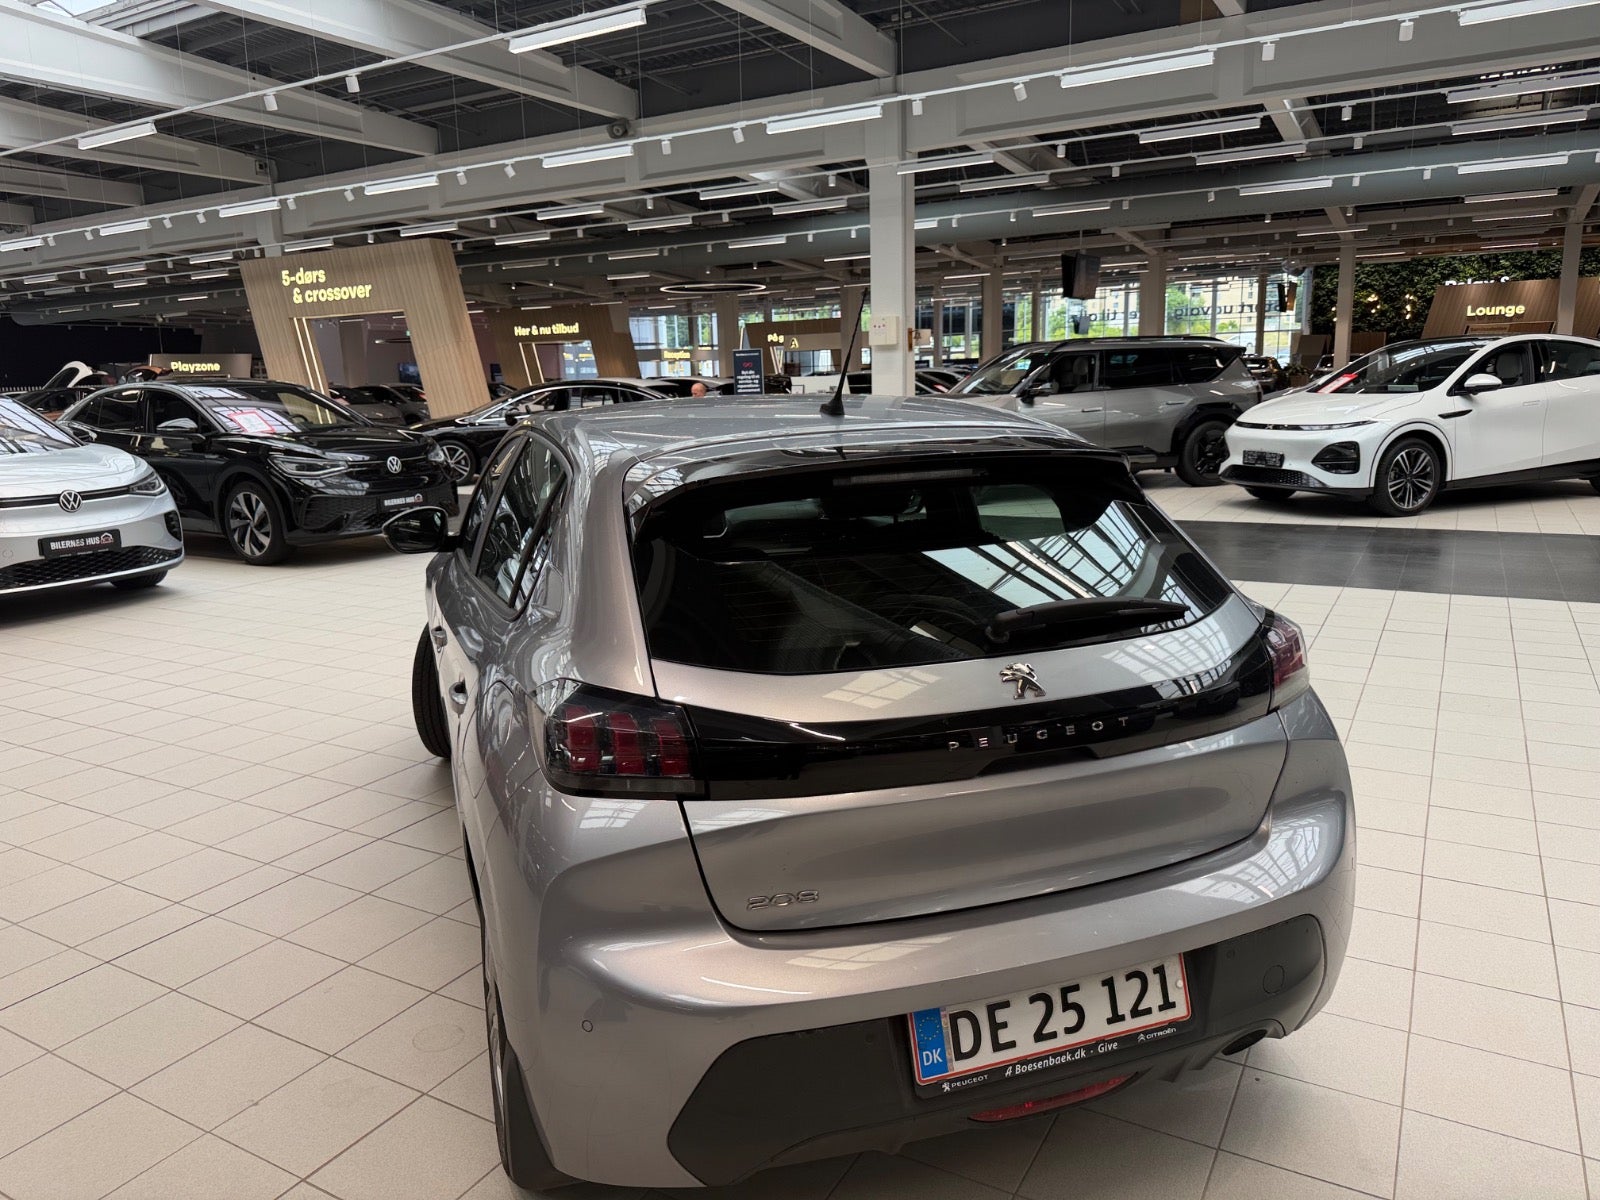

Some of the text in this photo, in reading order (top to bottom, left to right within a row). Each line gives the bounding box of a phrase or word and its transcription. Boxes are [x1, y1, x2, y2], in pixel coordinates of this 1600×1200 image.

[281, 267, 326, 286] 5-dørs
[293, 284, 372, 304] & crossover
[1466, 305, 1525, 317] Lounge
[514, 322, 579, 336] Her & nu tilbud
[170, 361, 221, 374] Playzone
[50, 536, 100, 550] BILERNES HUS
[949, 716, 1129, 751] PEUGEOT
[746, 889, 819, 911] 208
[922, 963, 1177, 1066] DK DE 25 121
[1014, 1049, 1087, 1076] Boesenbaek.dk
[1097, 1040, 1119, 1054] Give
[951, 1074, 989, 1089] PEUGEOT
